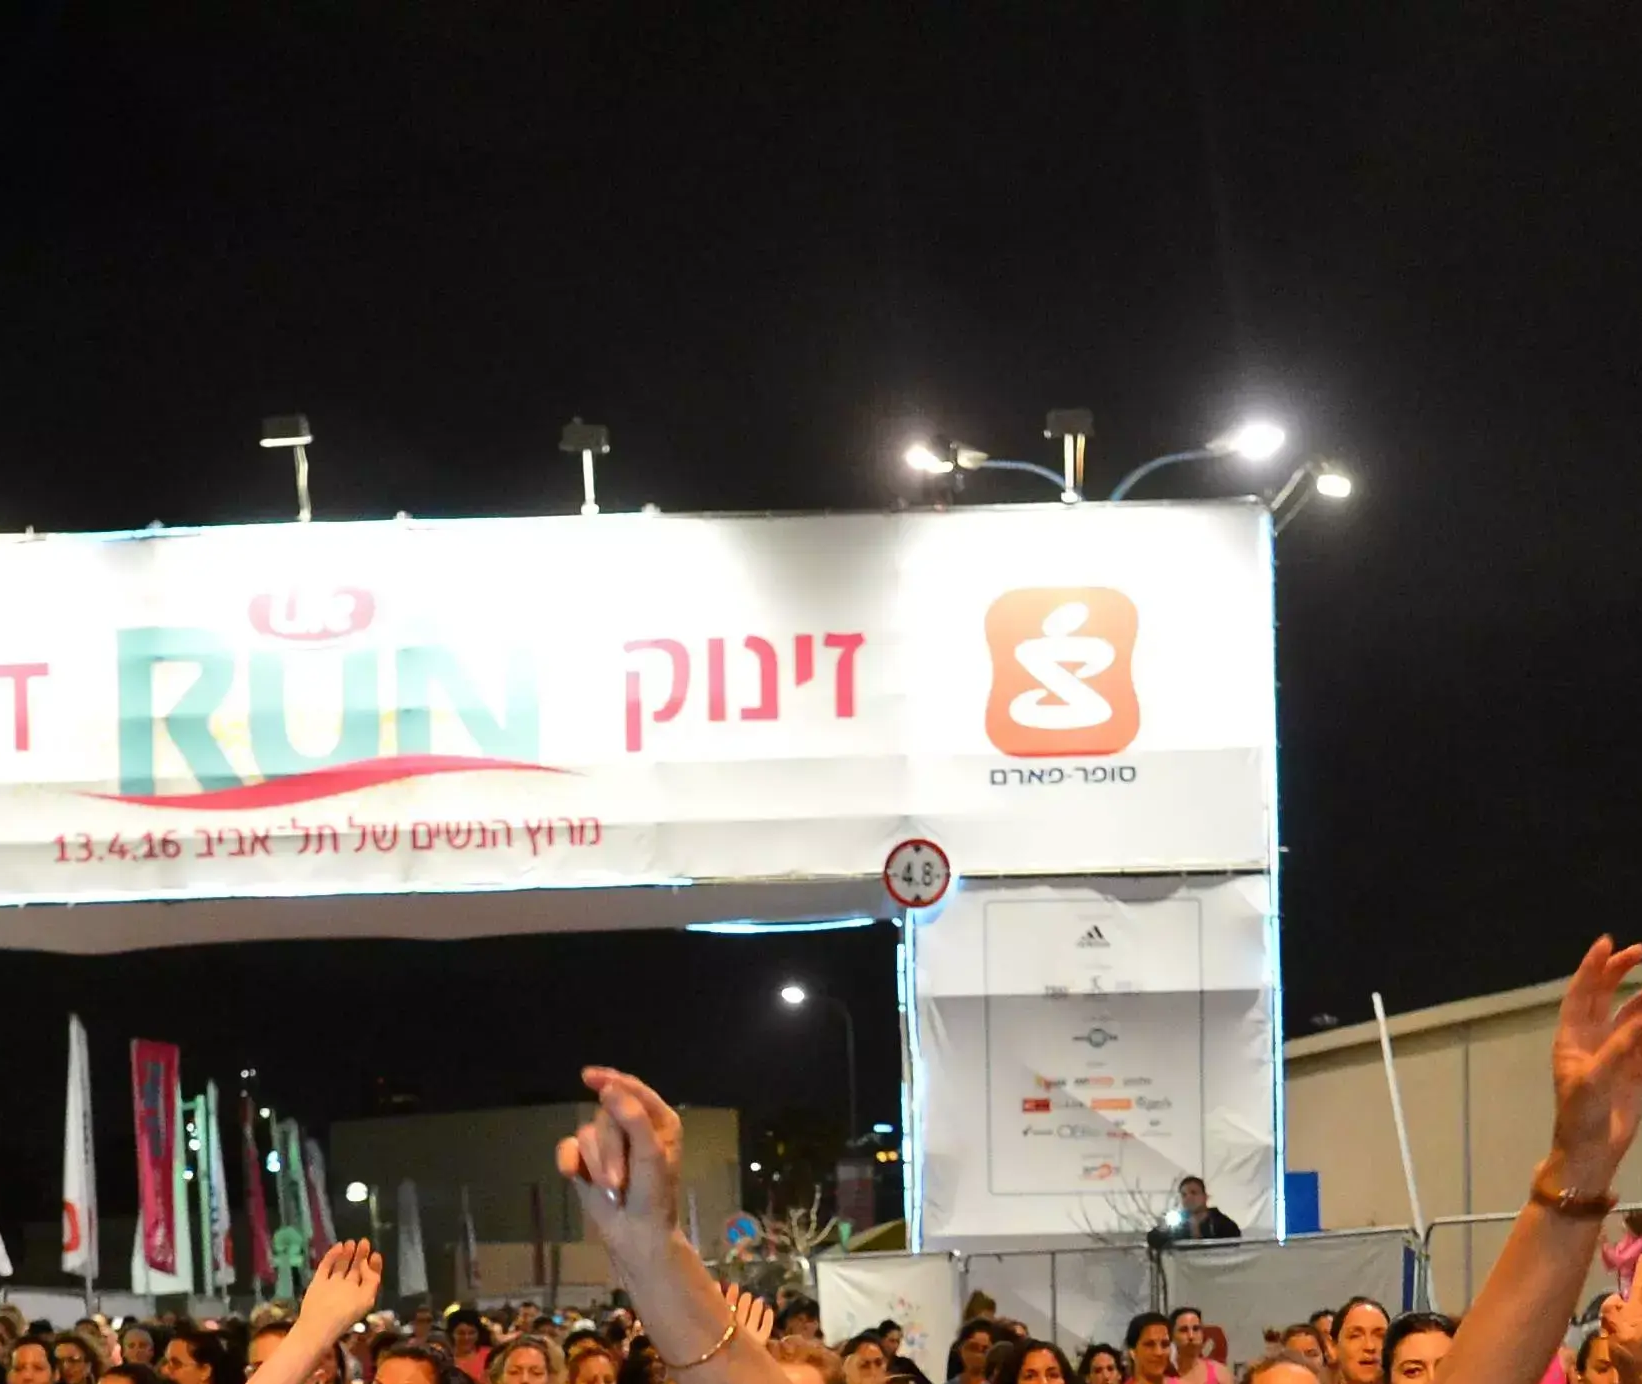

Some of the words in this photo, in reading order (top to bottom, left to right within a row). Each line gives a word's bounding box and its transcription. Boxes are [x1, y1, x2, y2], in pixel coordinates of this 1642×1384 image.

[623, 631, 866, 752] זינוק
[116, 625, 541, 796] RUN
[53, 833, 182, 864] 13.4.16
[347, 816, 399, 853] של
[410, 819, 513, 851] הנשים
[523, 816, 602, 856] מרוץ
[902, 861, 934, 888] 4.8
